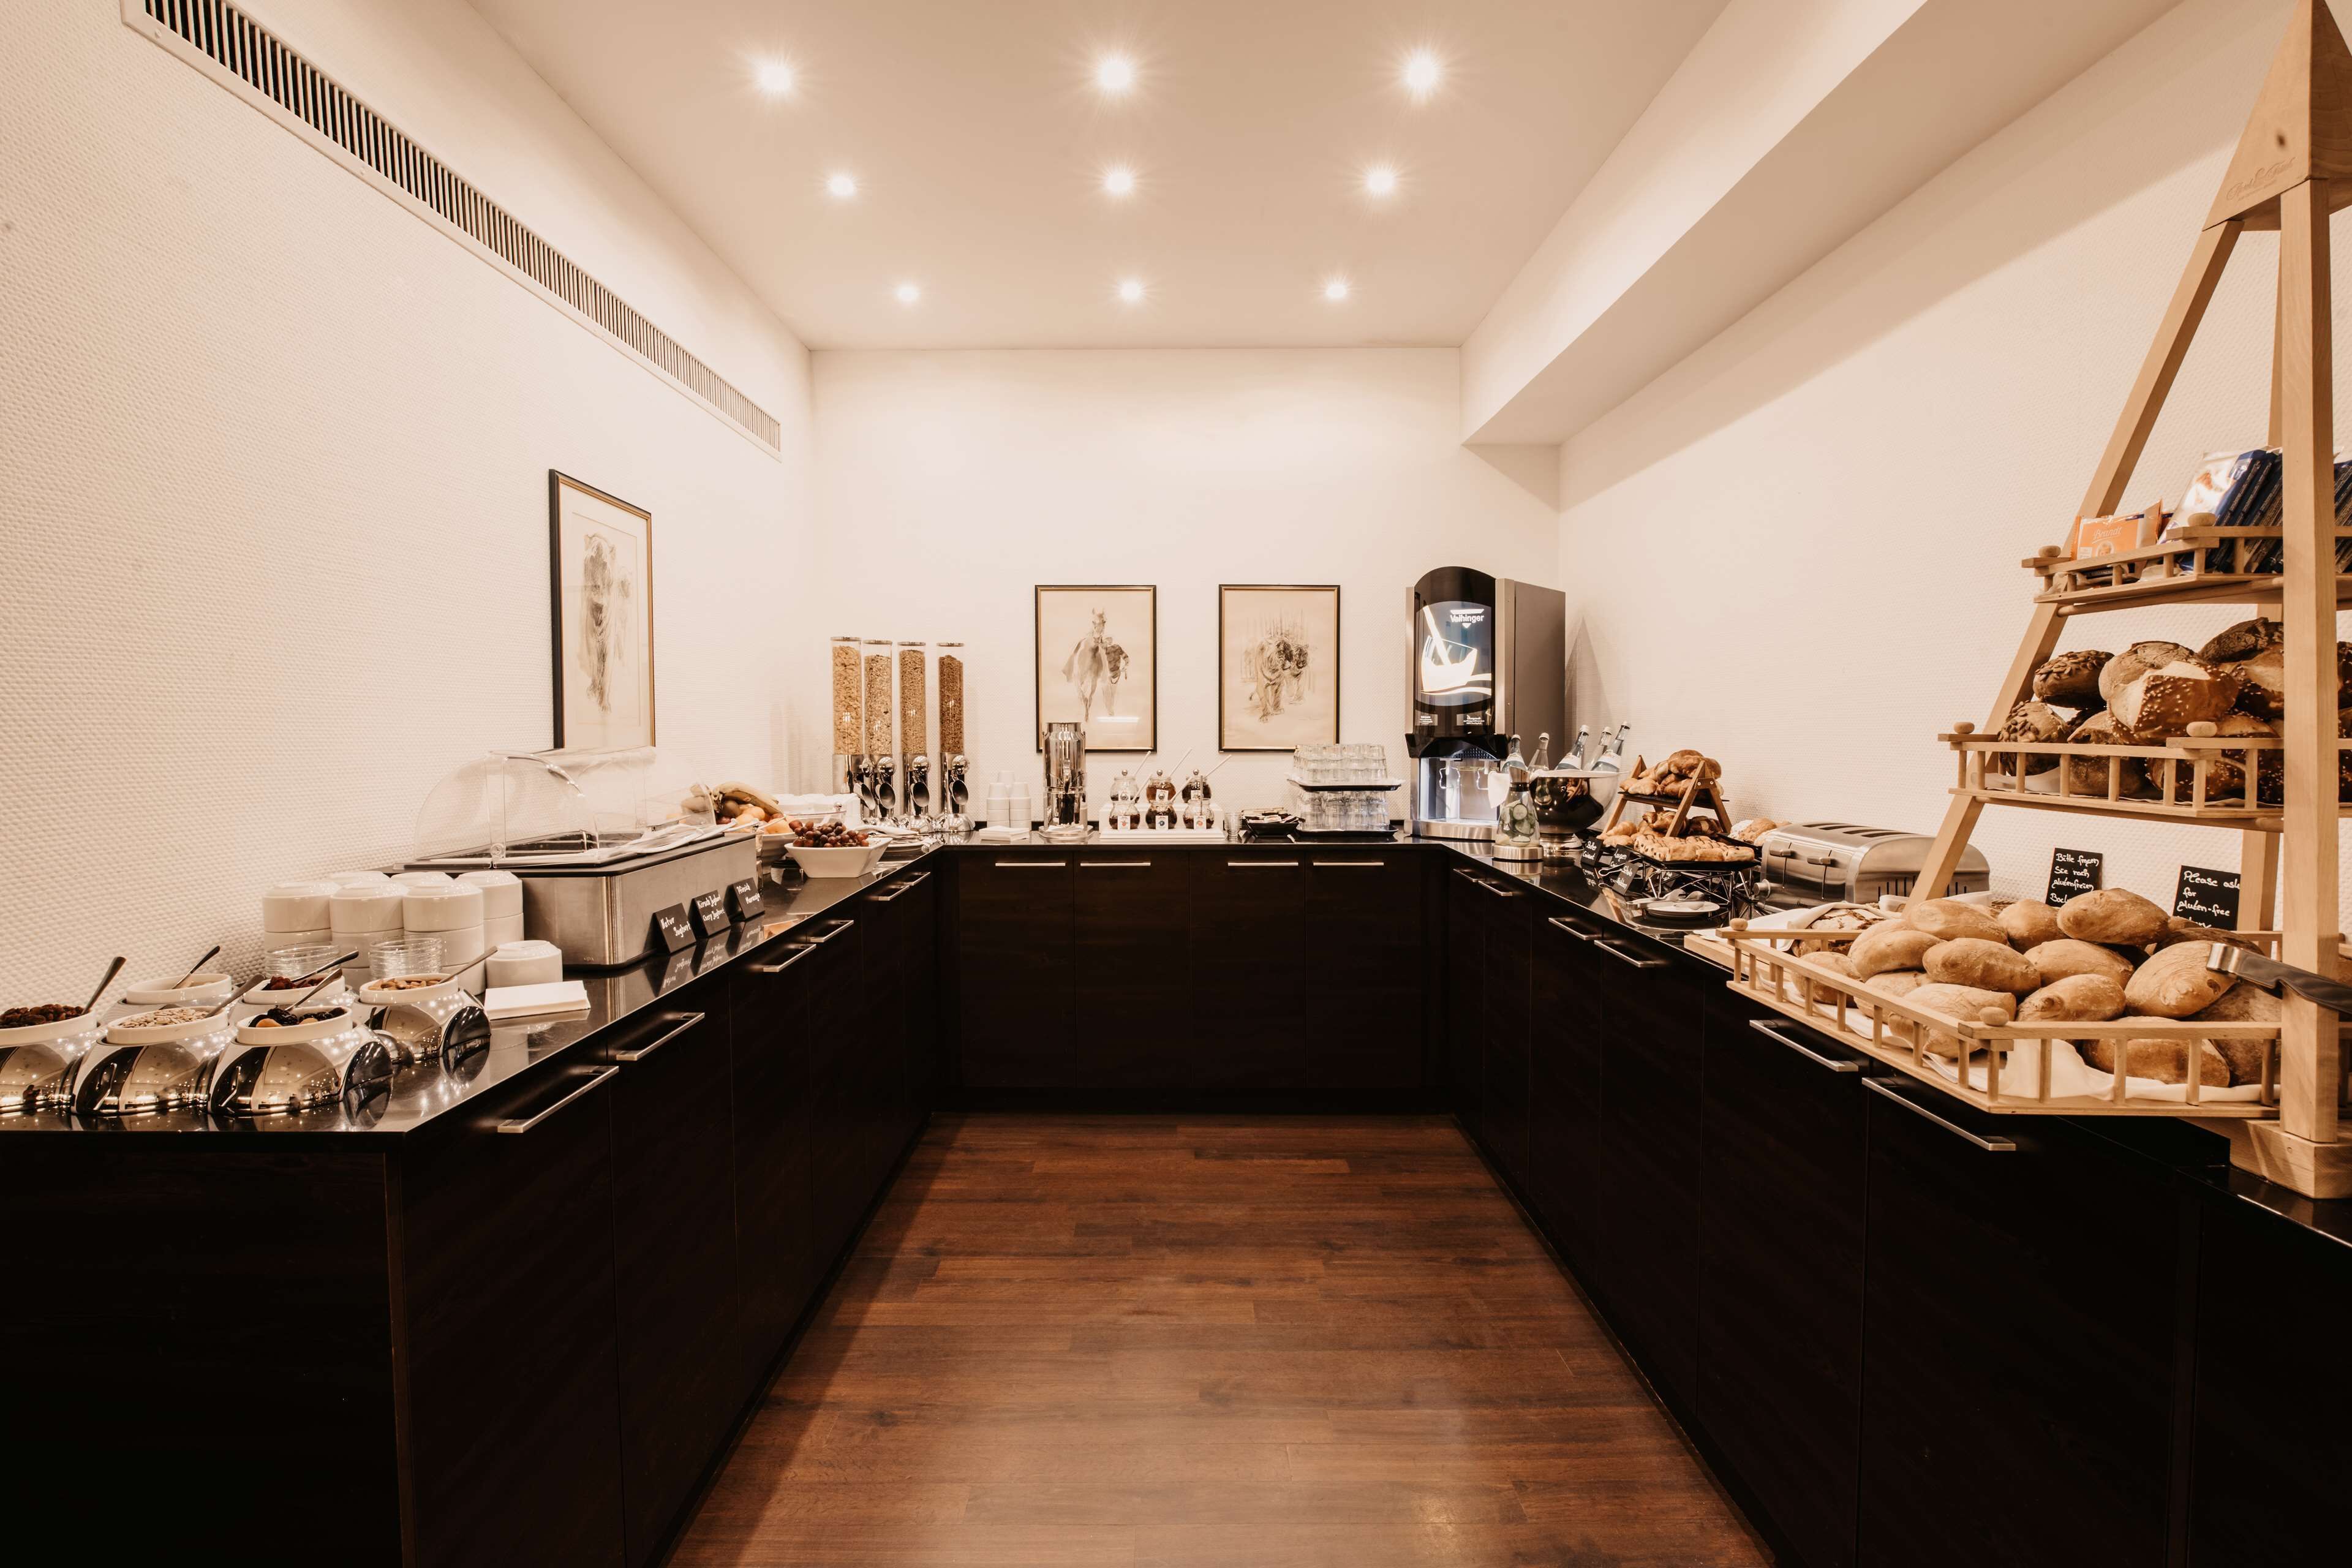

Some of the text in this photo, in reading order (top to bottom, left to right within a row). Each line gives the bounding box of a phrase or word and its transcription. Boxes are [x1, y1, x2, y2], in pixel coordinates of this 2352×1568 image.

[2094, 526, 2122, 539] Brandt
[1450, 614, 1485, 624] Vaihinger
[2056, 853, 2100, 867] Bitte fragen
[2054, 865, 2090, 878] Sie nach
[2051, 877, 2094, 892] glutenfreien
[2183, 870, 2218, 887] Please
[2182, 887, 2197, 899] for
[697, 897, 710, 909] Kirsch
[2176, 900, 2231, 917] gluten-free
[660, 917, 675, 929] Natur
[673, 921, 692, 938] Joghurt
